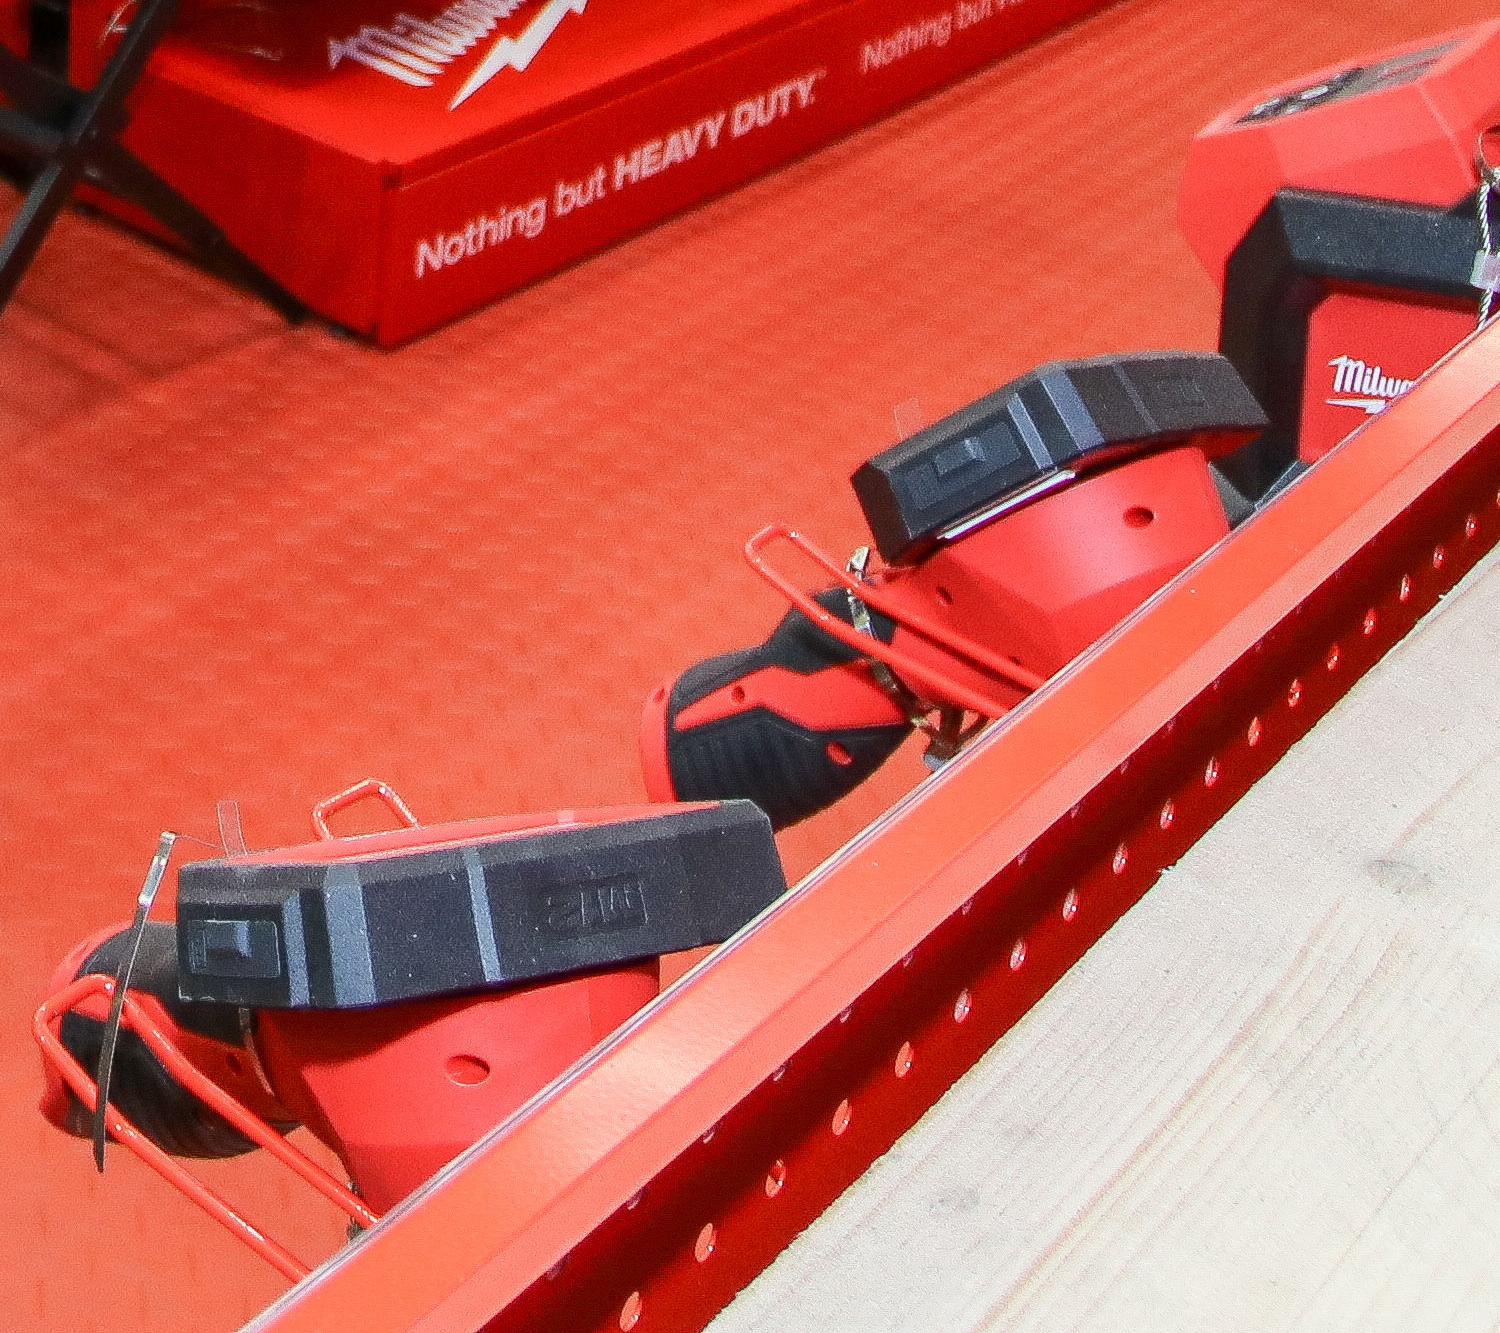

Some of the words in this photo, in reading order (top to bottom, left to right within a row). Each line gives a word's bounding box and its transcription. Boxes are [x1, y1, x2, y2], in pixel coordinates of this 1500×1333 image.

[858, 5, 955, 77] Nothing
[414, 195, 549, 278] Nothing
[551, 162, 607, 216] but
[612, 110, 727, 194] HEAVY
